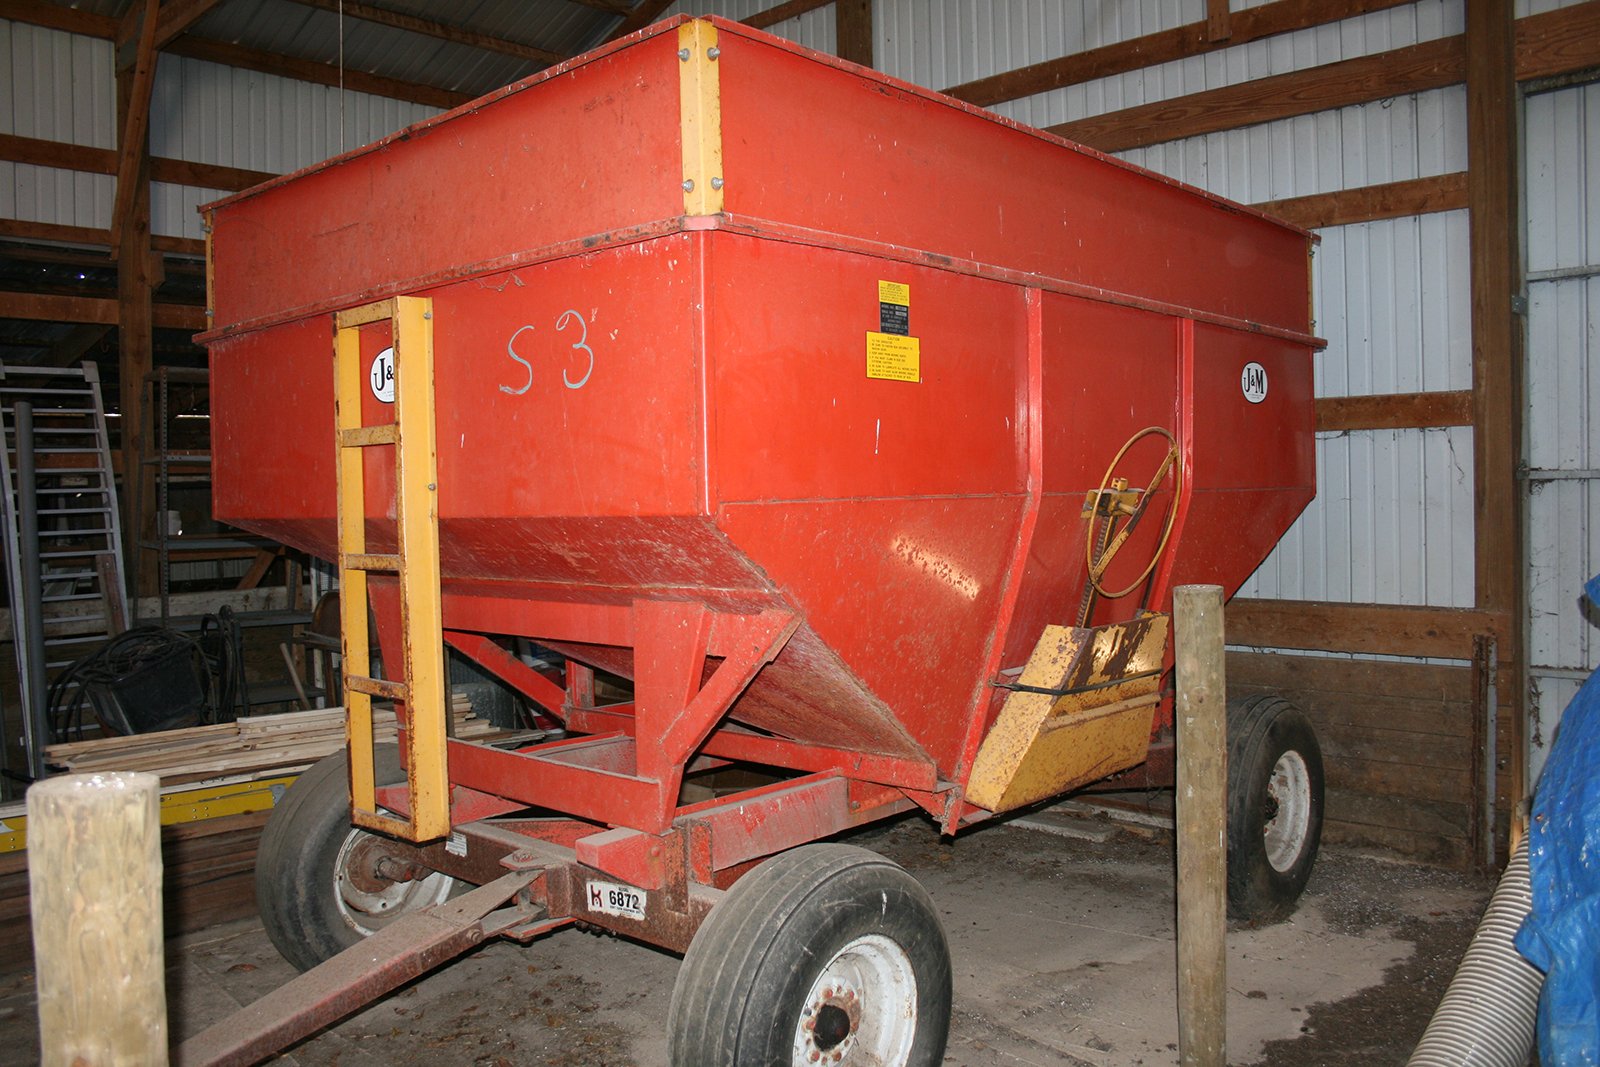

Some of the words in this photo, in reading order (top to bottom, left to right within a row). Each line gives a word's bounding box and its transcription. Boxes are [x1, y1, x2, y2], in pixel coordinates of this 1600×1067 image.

[499, 325, 535, 395] S
[556, 309, 604, 389] 3
[373, 357, 394, 391] J&
[1243, 367, 1264, 394] J&M
[609, 890, 641, 910] 6872
